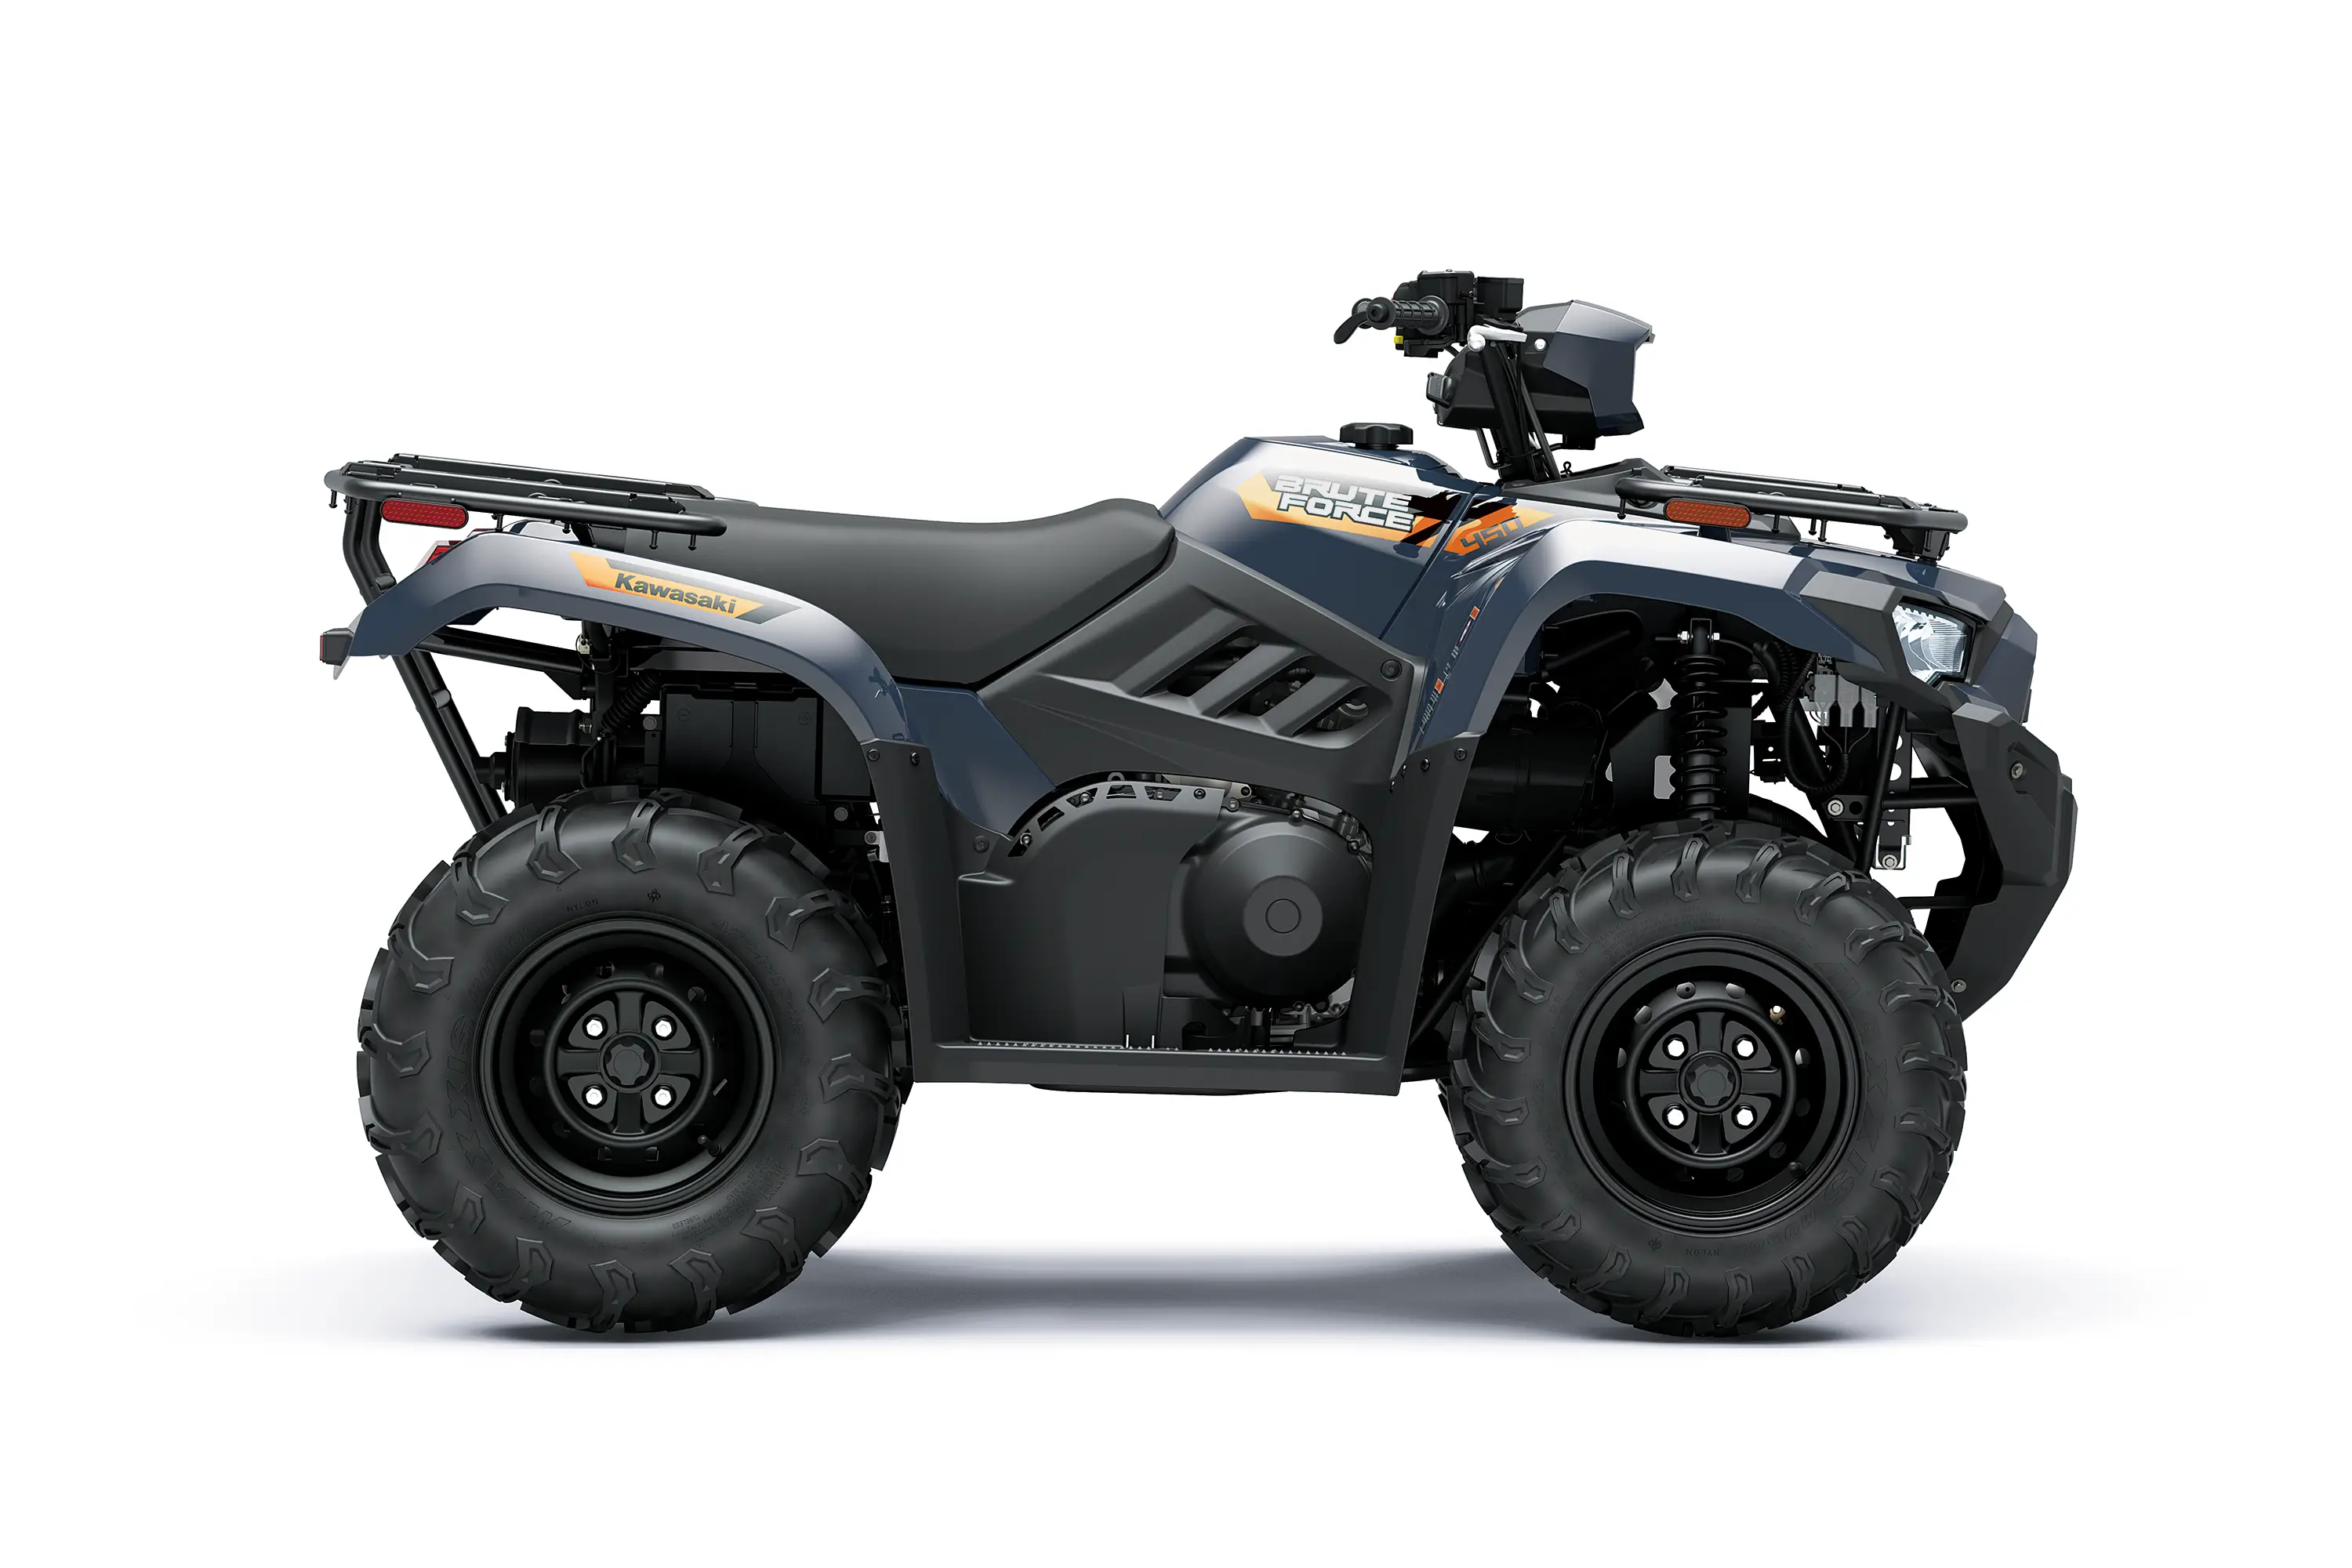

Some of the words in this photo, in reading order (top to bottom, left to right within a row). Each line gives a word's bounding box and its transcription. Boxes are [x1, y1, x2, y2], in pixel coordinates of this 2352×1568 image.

[1274, 474, 1412, 512] BRUTE
[1277, 492, 1415, 533] FORCE
[1460, 517, 1523, 550] 450
[615, 572, 736, 614] Kawasaki
[567, 897, 599, 913] NYLON
[446, 1014, 572, 1235] MAXXIS
[672, 1214, 701, 1230] TUBELESS
[1686, 1247, 1720, 1258] NYLON
